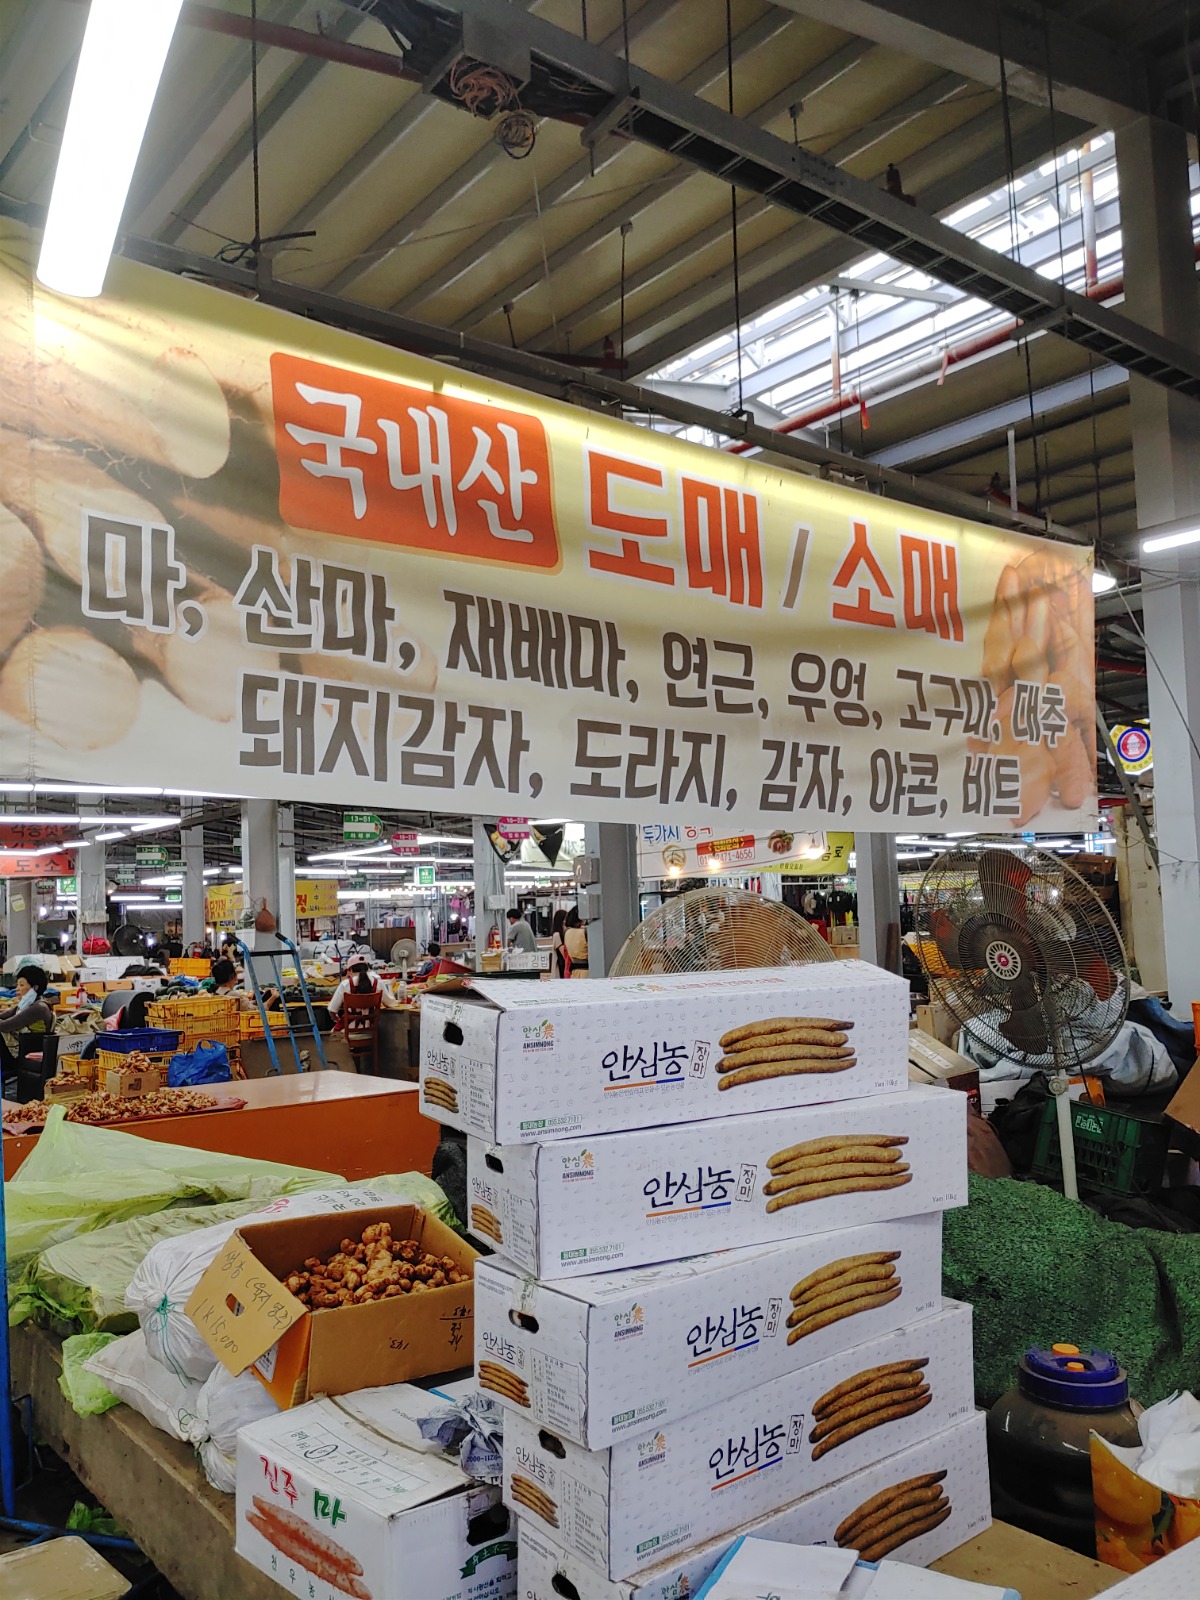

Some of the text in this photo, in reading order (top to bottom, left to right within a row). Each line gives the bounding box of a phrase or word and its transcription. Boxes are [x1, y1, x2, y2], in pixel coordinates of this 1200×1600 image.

[285, 382, 538, 543] 국내산
[588, 450, 763, 608] 도매
[832, 523, 964, 642] 소매
[85, 514, 1068, 745] 마, 산마, 재배마, 연근, 우엉, 고구마, 대추
[240, 674, 543, 799] 돼지감자,
[570, 719, 737, 811] 도라지,
[759, 740, 852, 817] 감자,
[962, 757, 1022, 817] 비트
[531, 954, 549, 968] 김밥
[602, 1041, 689, 1082] 안심농
[693, 1046, 708, 1076] 장마
[520, 1124, 582, 1138] www.ansimnong.com
[643, 1166, 735, 1208] 안심농
[741, 1169, 754, 1198] 장마
[561, 1252, 624, 1268] www.ansimnong.com
[687, 1304, 764, 1357] 안심농
[768, 1303, 780, 1333] 장마
[482, 1331, 516, 1361] 안심농
[709, 1424, 786, 1480] 안심농
[789, 1419, 802, 1450] 장마
[516, 1447, 547, 1480] 안심농
[259, 1454, 299, 1509] 진주
[314, 1488, 347, 1528] 마
